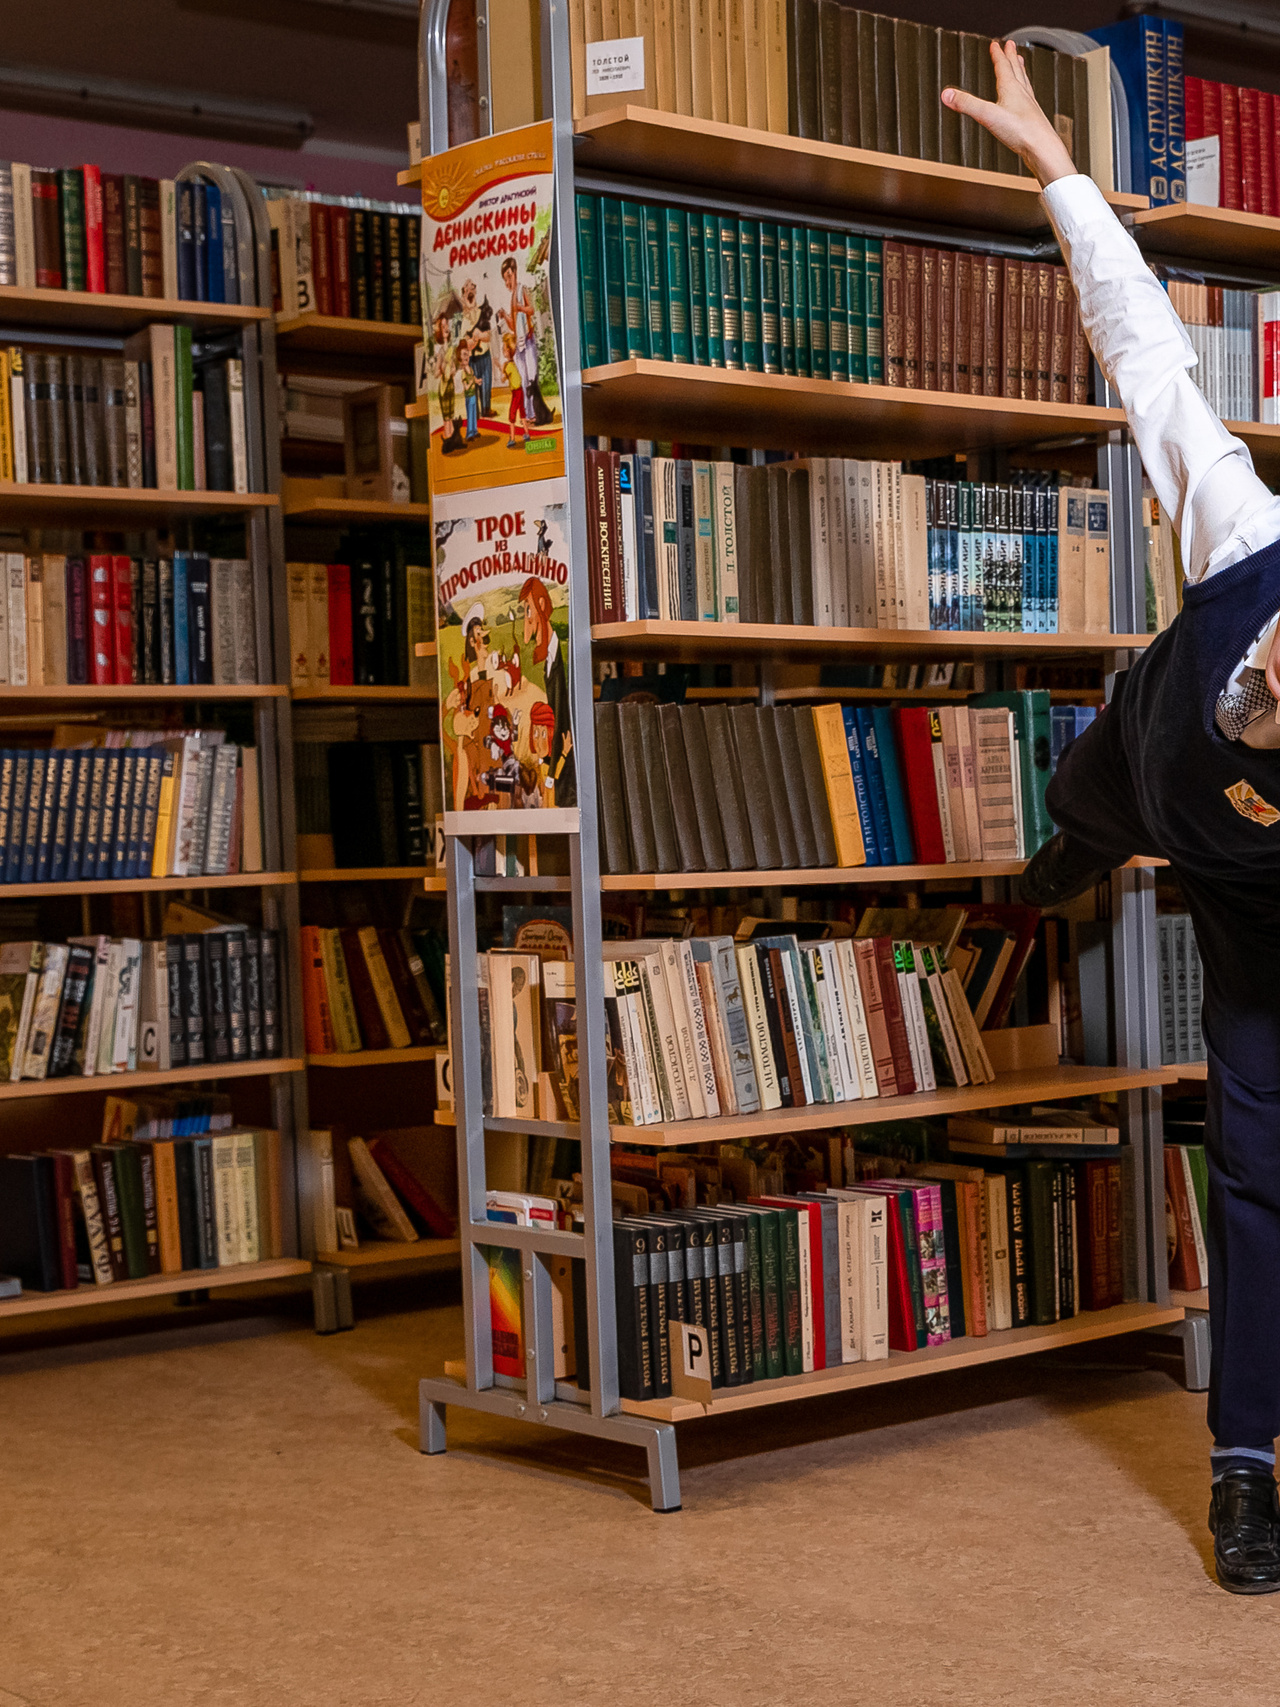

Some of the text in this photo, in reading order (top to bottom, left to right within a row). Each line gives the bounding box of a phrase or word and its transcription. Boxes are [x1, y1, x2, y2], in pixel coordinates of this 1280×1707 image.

[593, 54, 629, 66] ТОЛСТОЙ
[1146, 29, 1167, 171] А.С.ПУШКИН
[1167, 35, 1185, 173] А.С.ПУШКИН
[479, 186, 537, 209] ВИКТОР ДРАГУНСКИЙ
[433, 201, 536, 252] ДЕНИСКИНЫ
[449, 226, 535, 268] РАССКАЗЫ
[475, 511, 526, 542] ТРОЕ
[722, 485, 733, 556] ТОЛСТОЙ
[495, 540, 508, 552] ИЗ
[440, 551, 568, 604] ПРОСТОКВАШИНО
[599, 522, 613, 610] ВОСКРЕСЕНИЕ
[880, 598, 887, 608] 2
[143, 1028, 155, 1056] С
[1012, 1182, 1023, 1232] АРБАТА
[636, 1238, 645, 1253] 9
[656, 1236, 664, 1250] 8
[675, 1234, 680, 1248] 7
[690, 1232, 699, 1246] 6
[704, 1231, 713, 1245] 4
[722, 1228, 731, 1242] 3
[676, 1283, 684, 1322] ОЛЛАН
[640, 1287, 651, 1387] РОМЕН РОЛЛАН
[657, 1284, 668, 1383] РОМЕН РОЛЛАН
[709, 1278, 720, 1376] РОМЕН РОЛЛАН
[725, 1277, 738, 1373] РОМЕН РОЛЛАН
[688, 1332, 702, 1371] Р
[743, 1325, 752, 1370] РОМЕН
